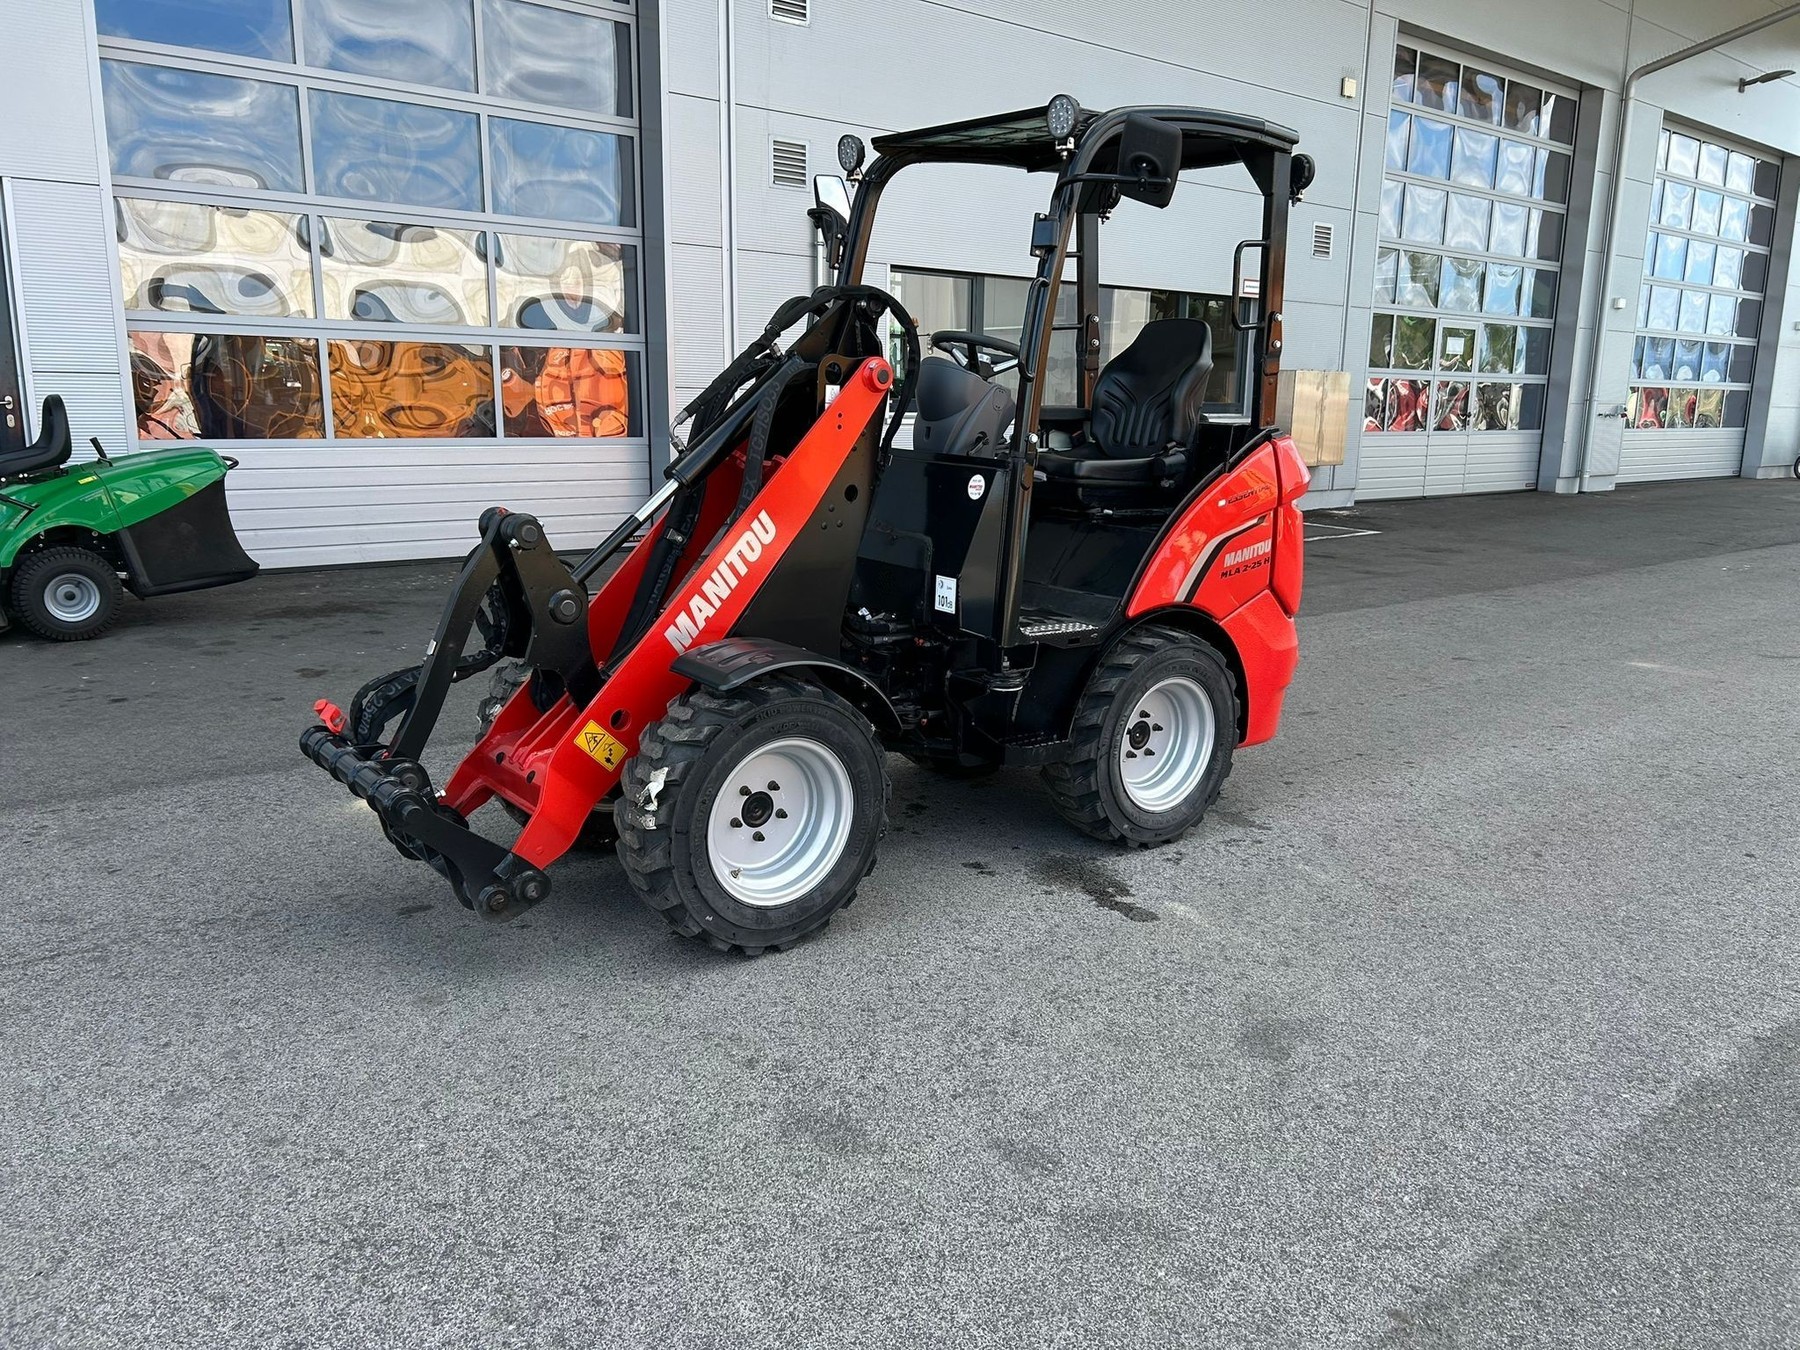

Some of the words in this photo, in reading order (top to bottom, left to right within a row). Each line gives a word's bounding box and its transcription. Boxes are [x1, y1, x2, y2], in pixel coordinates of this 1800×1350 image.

[1225, 539, 1271, 567] MANITOU
[664, 509, 777, 655] MANITOU
[1220, 567, 1241, 580] MLA
[1242, 559, 1262, 573] 2-25
[1263, 557, 1271, 565] H
